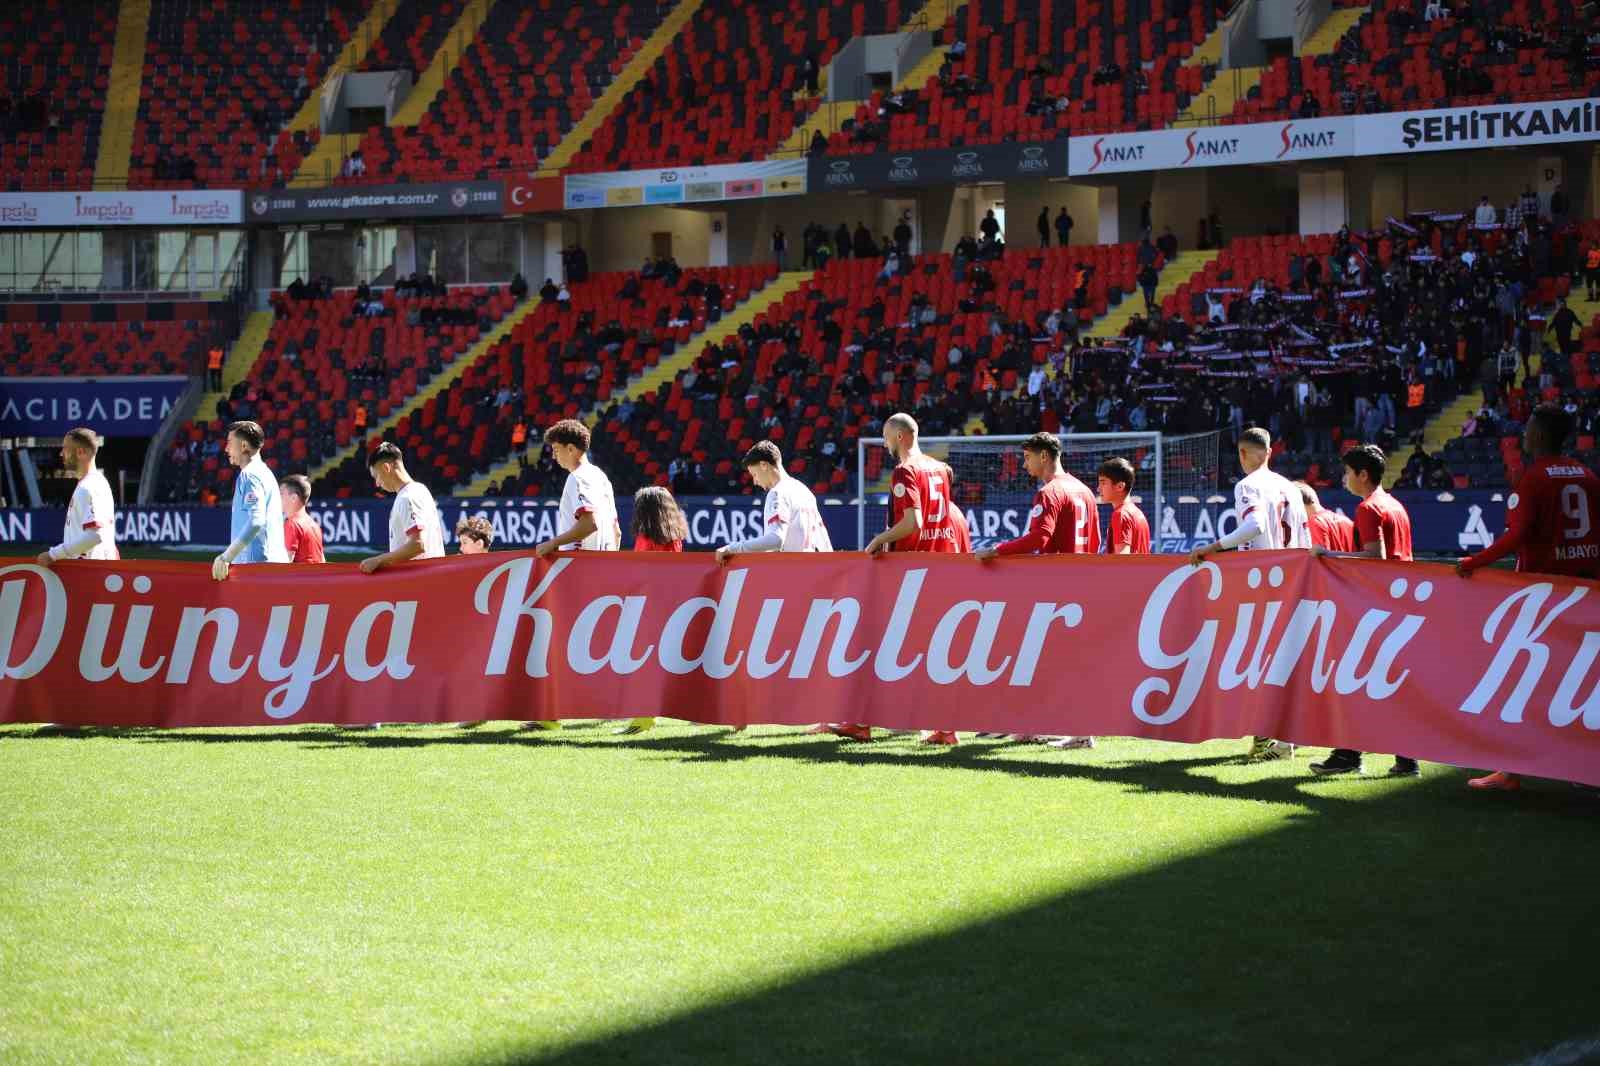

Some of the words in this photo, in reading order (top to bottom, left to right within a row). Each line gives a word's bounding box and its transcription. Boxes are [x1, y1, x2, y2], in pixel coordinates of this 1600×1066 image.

[1088, 137, 1145, 172] SANAT
[1181, 130, 1239, 165] SANAT
[1276, 123, 1336, 159] SANAT
[928, 476, 945, 523] 5
[1561, 484, 1591, 539] 9
[474, 556, 1083, 688] Kadınlar
[1131, 561, 1434, 725] Günü
